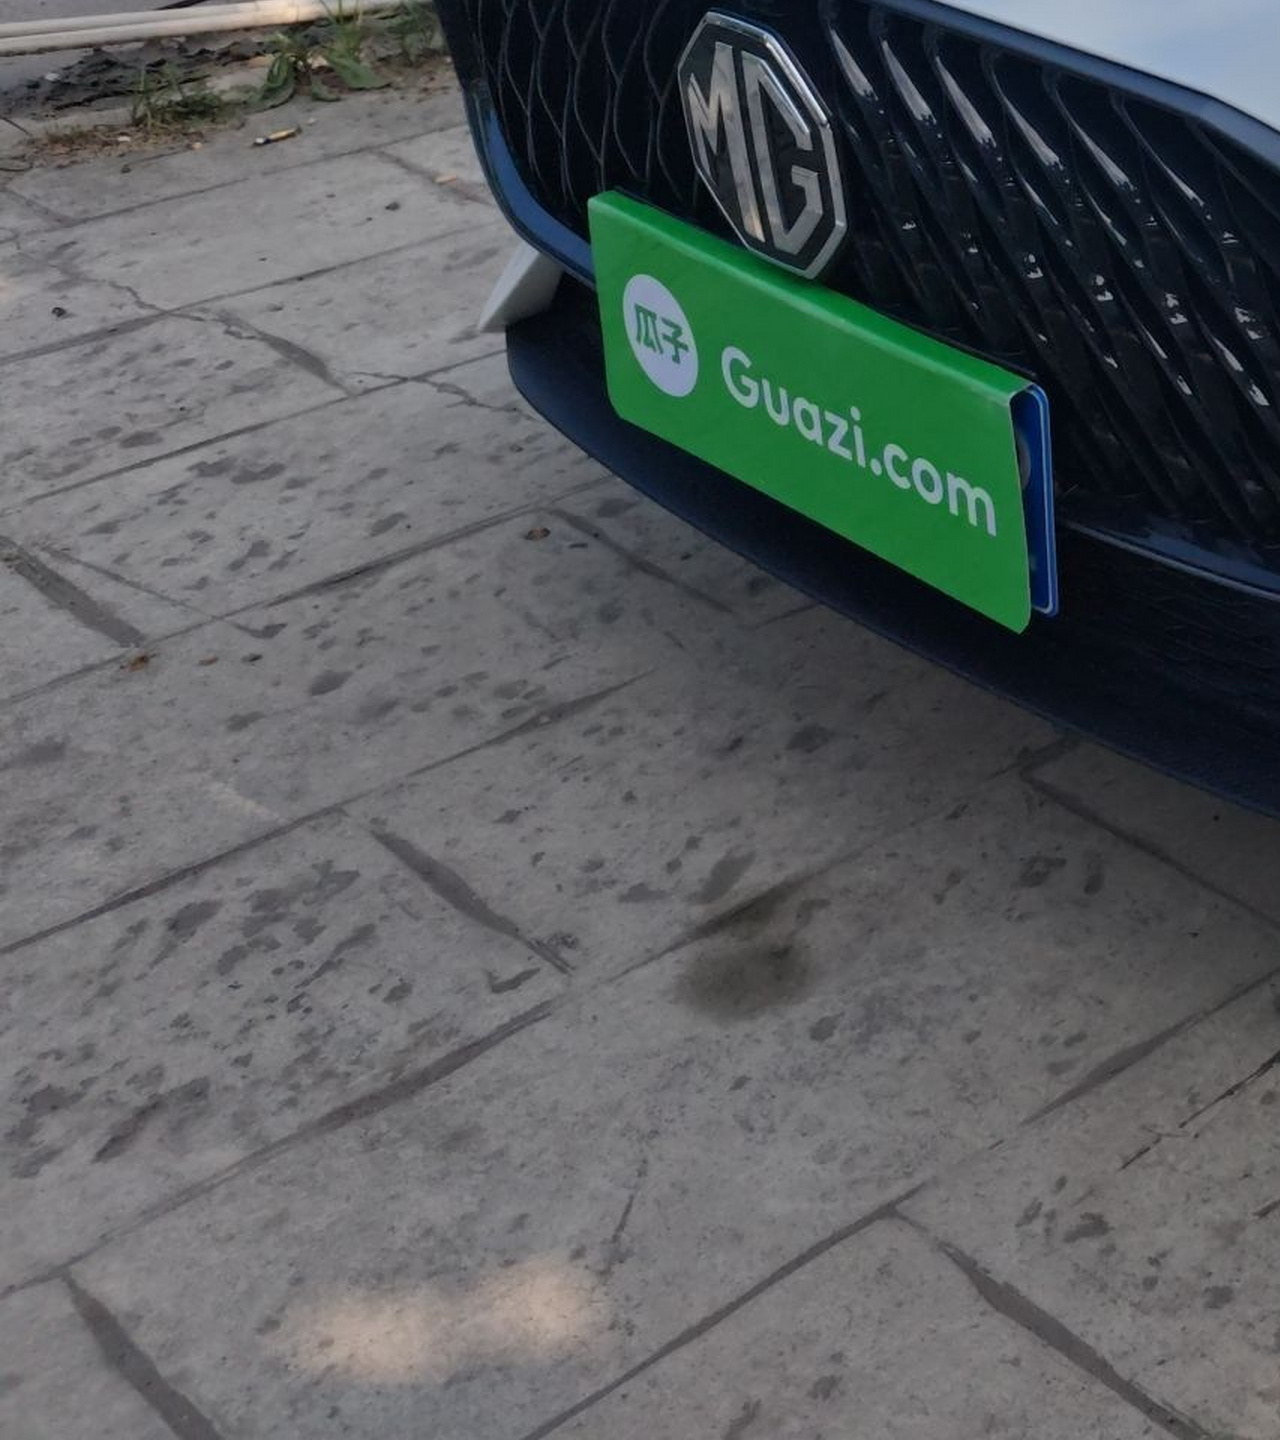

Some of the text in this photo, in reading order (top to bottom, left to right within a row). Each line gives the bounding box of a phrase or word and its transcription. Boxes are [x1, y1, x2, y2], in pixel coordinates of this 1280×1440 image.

[687, 41, 823, 256] MG
[633, 302, 690, 365] 瓜子
[720, 345, 997, 537] Guazi.com
